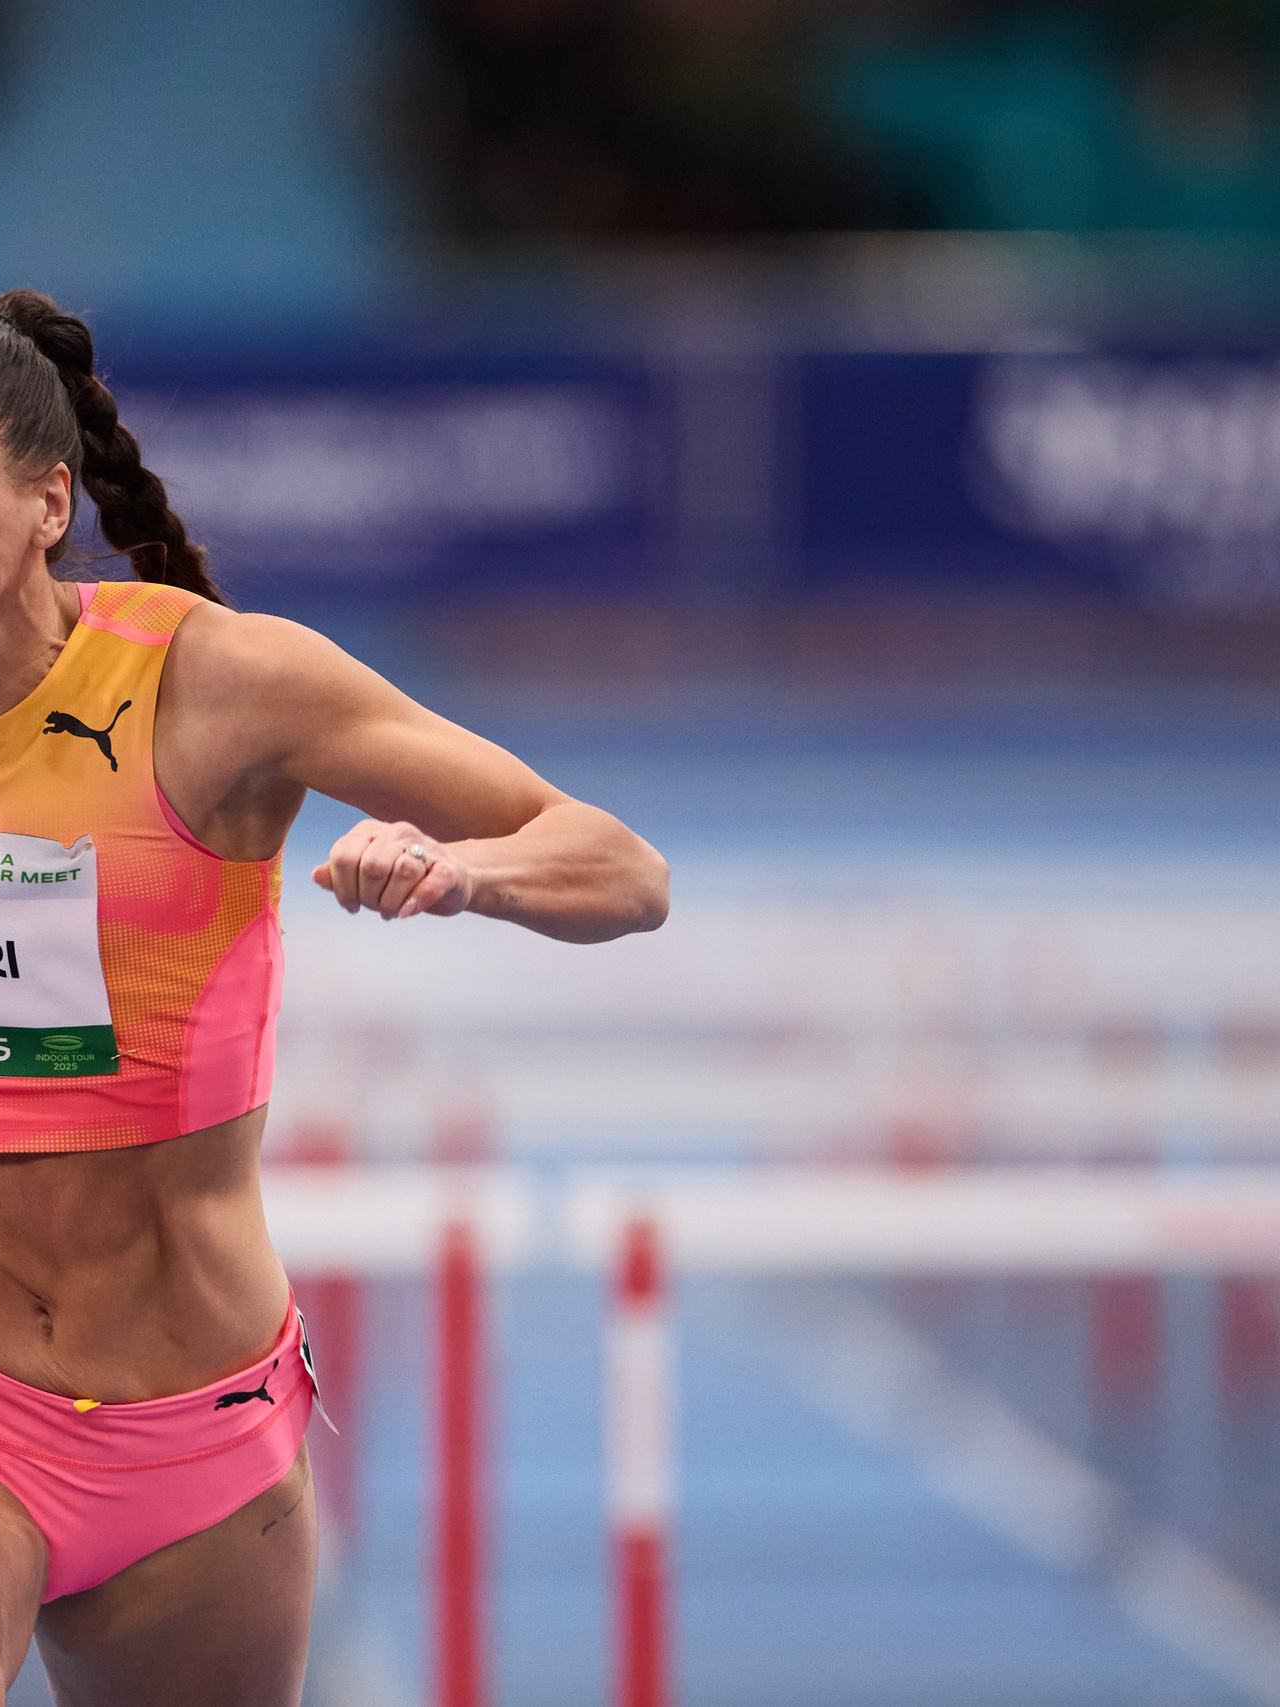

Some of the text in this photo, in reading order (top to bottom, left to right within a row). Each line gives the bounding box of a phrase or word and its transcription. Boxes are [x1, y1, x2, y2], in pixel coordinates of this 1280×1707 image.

[20, 868, 82, 884] MEET
[35, 1053, 95, 1062] INDOOR TOUR
[53, 1062, 78, 1071] 2025
